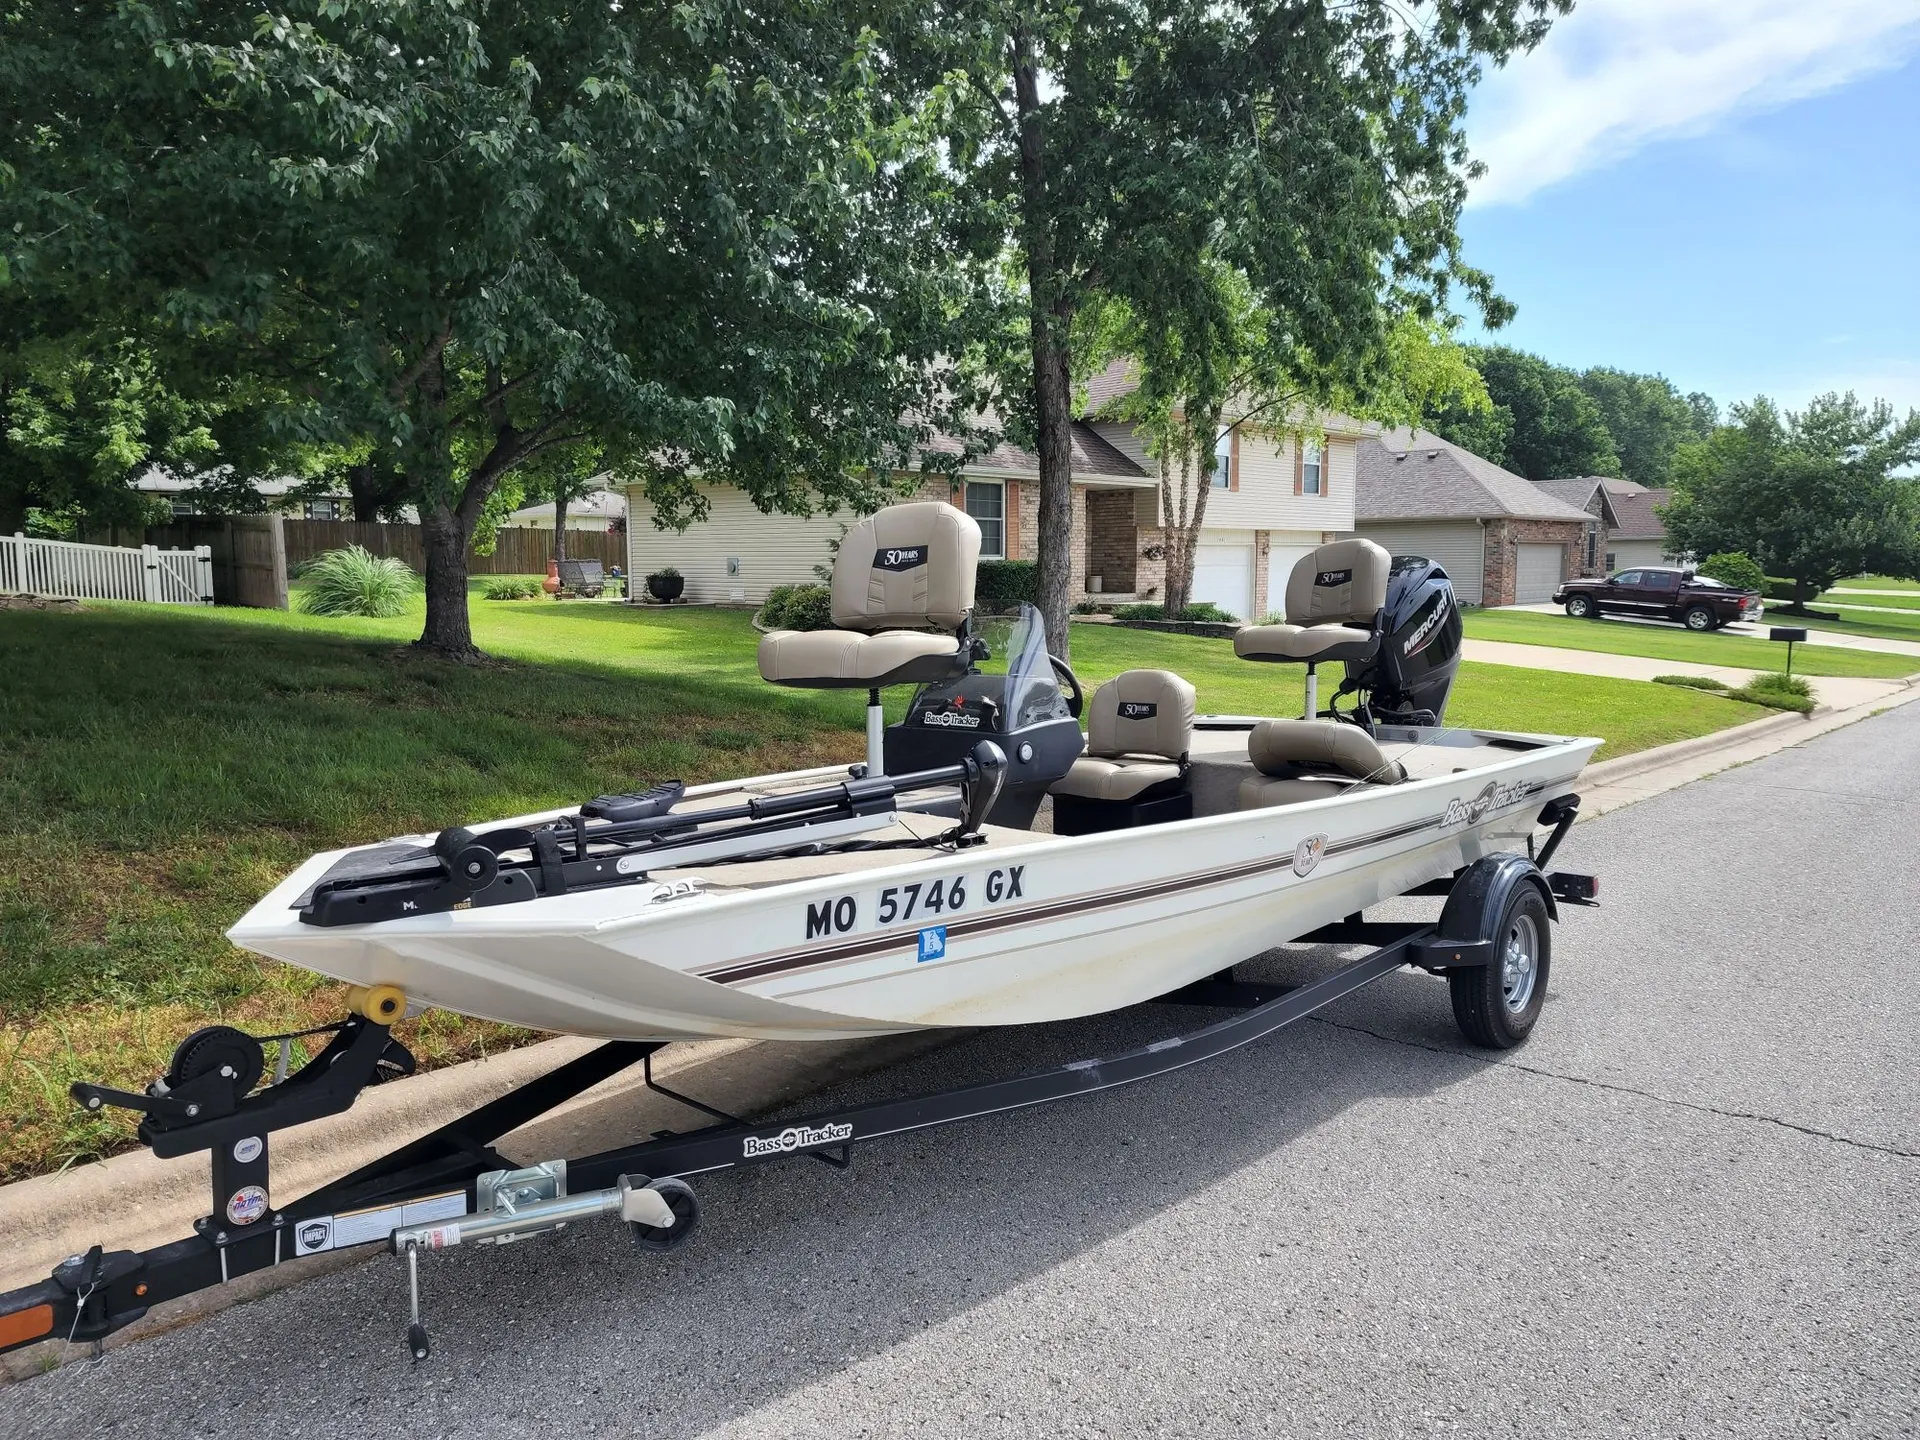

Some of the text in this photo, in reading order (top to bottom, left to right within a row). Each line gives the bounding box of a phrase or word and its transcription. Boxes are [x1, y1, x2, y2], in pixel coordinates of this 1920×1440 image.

[884, 550, 919, 565] 50 YEARS
[1321, 572, 1334, 583] 50
[1403, 588, 1448, 655] MERCURY
[1125, 704, 1138, 715] 50
[925, 712, 980, 726] Bass Tracker
[1440, 781, 1532, 829] Bass Tracker
[454, 902, 472, 910] EDGE
[805, 865, 1025, 940] MO 5746 GX
[745, 1125, 852, 1156] Bass Tracker
[303, 1227, 326, 1243] IMPACT
